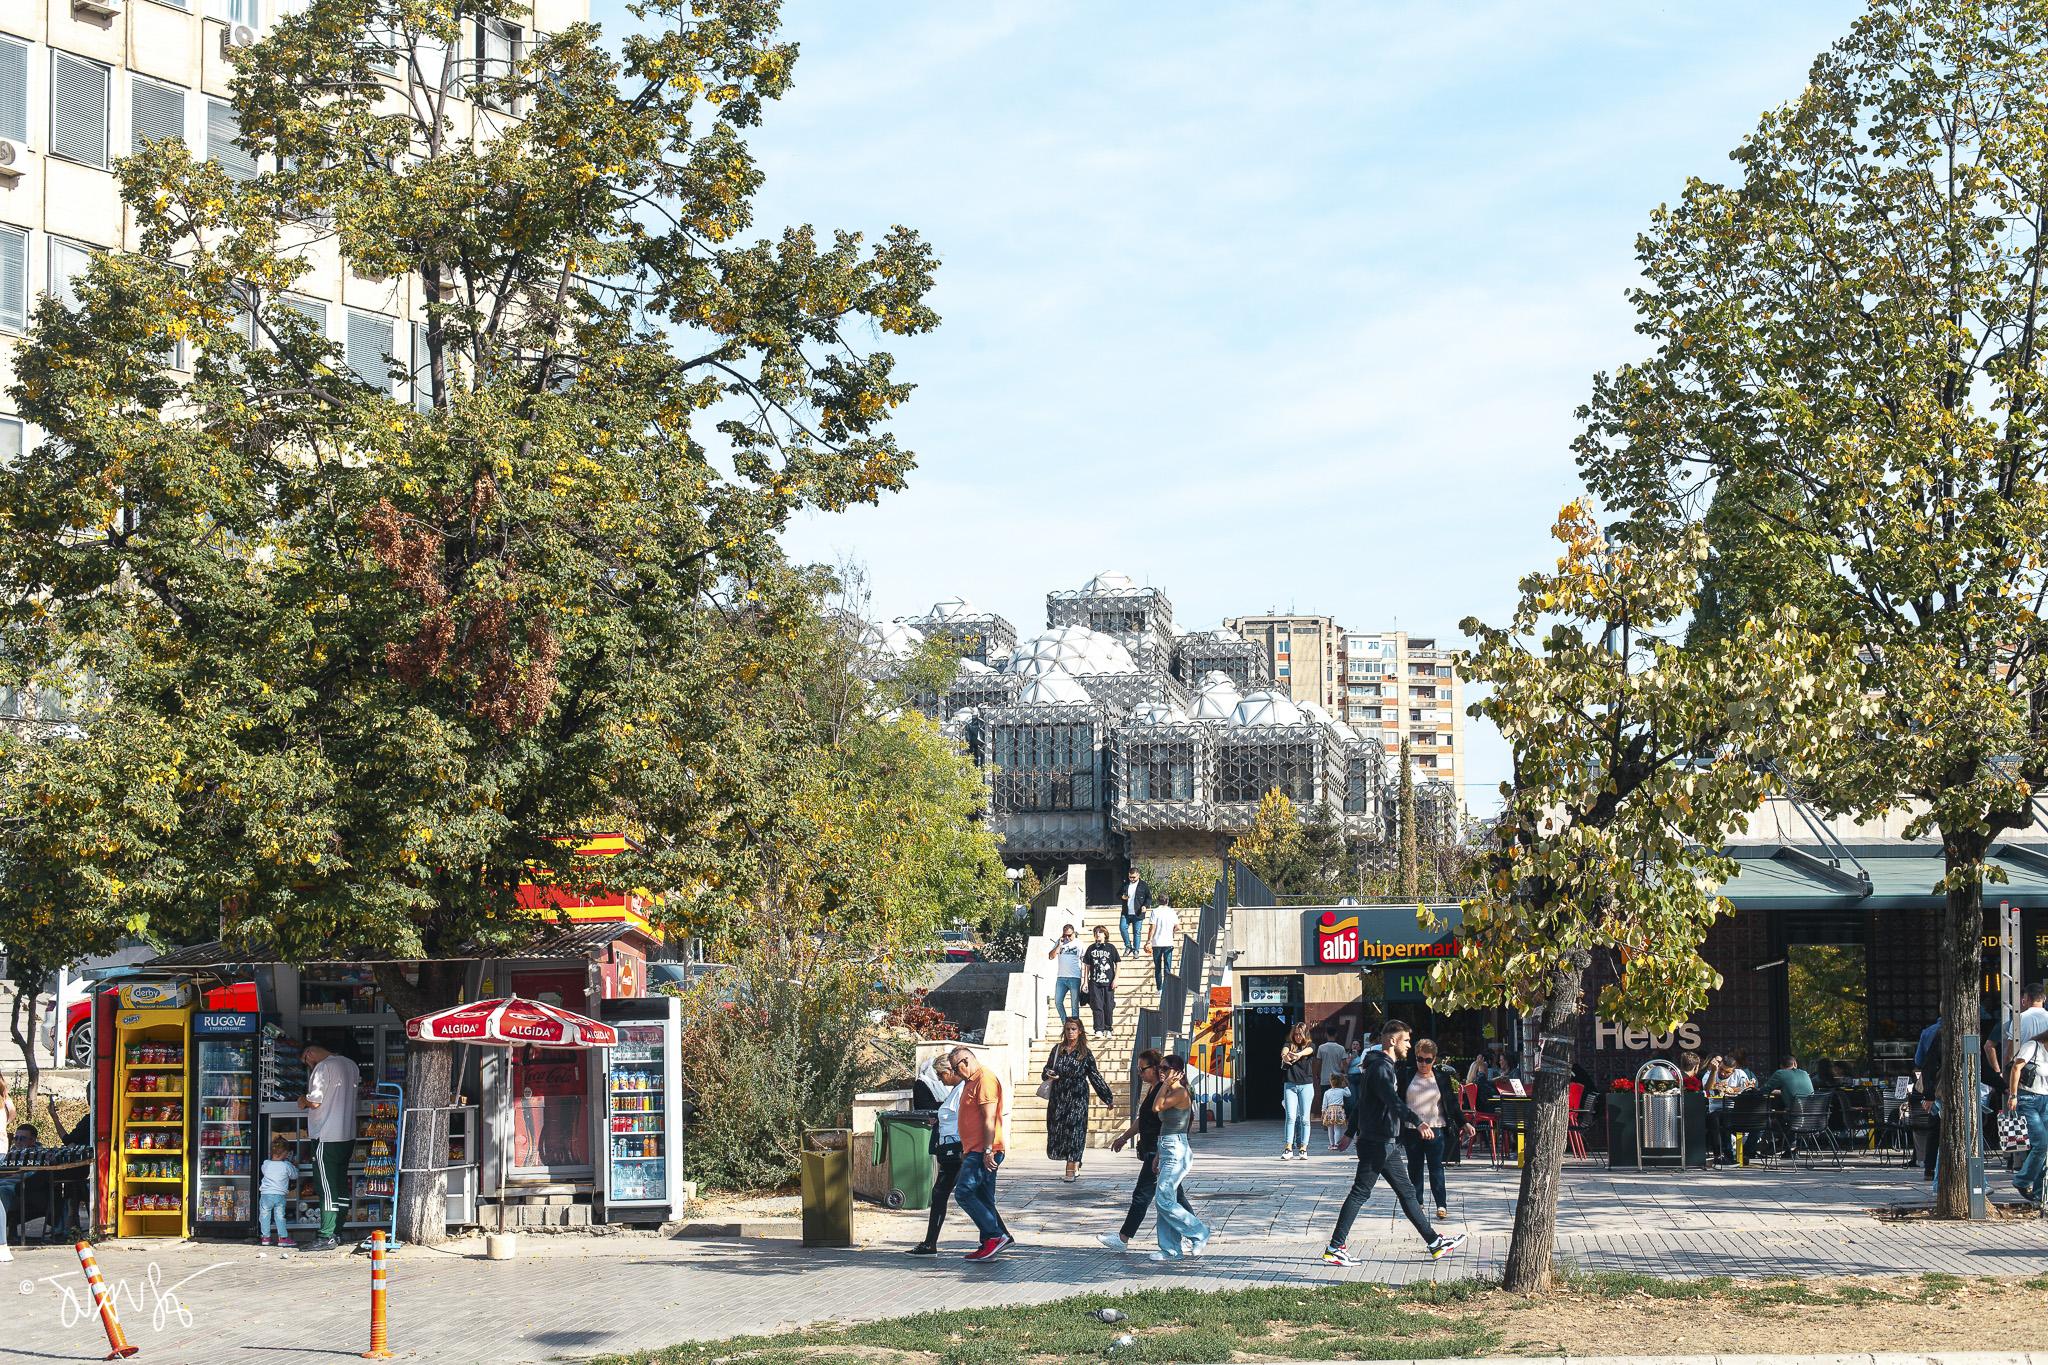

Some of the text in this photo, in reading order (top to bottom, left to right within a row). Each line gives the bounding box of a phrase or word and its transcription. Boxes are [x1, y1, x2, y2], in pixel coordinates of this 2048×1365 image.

[1323, 932, 1466, 961] albi hipermark
[1401, 975, 1426, 992] HY
[134, 987, 158, 998] derby
[204, 1016, 246, 1026] RUGOVE
[1595, 1016, 1702, 1050] Hebs
